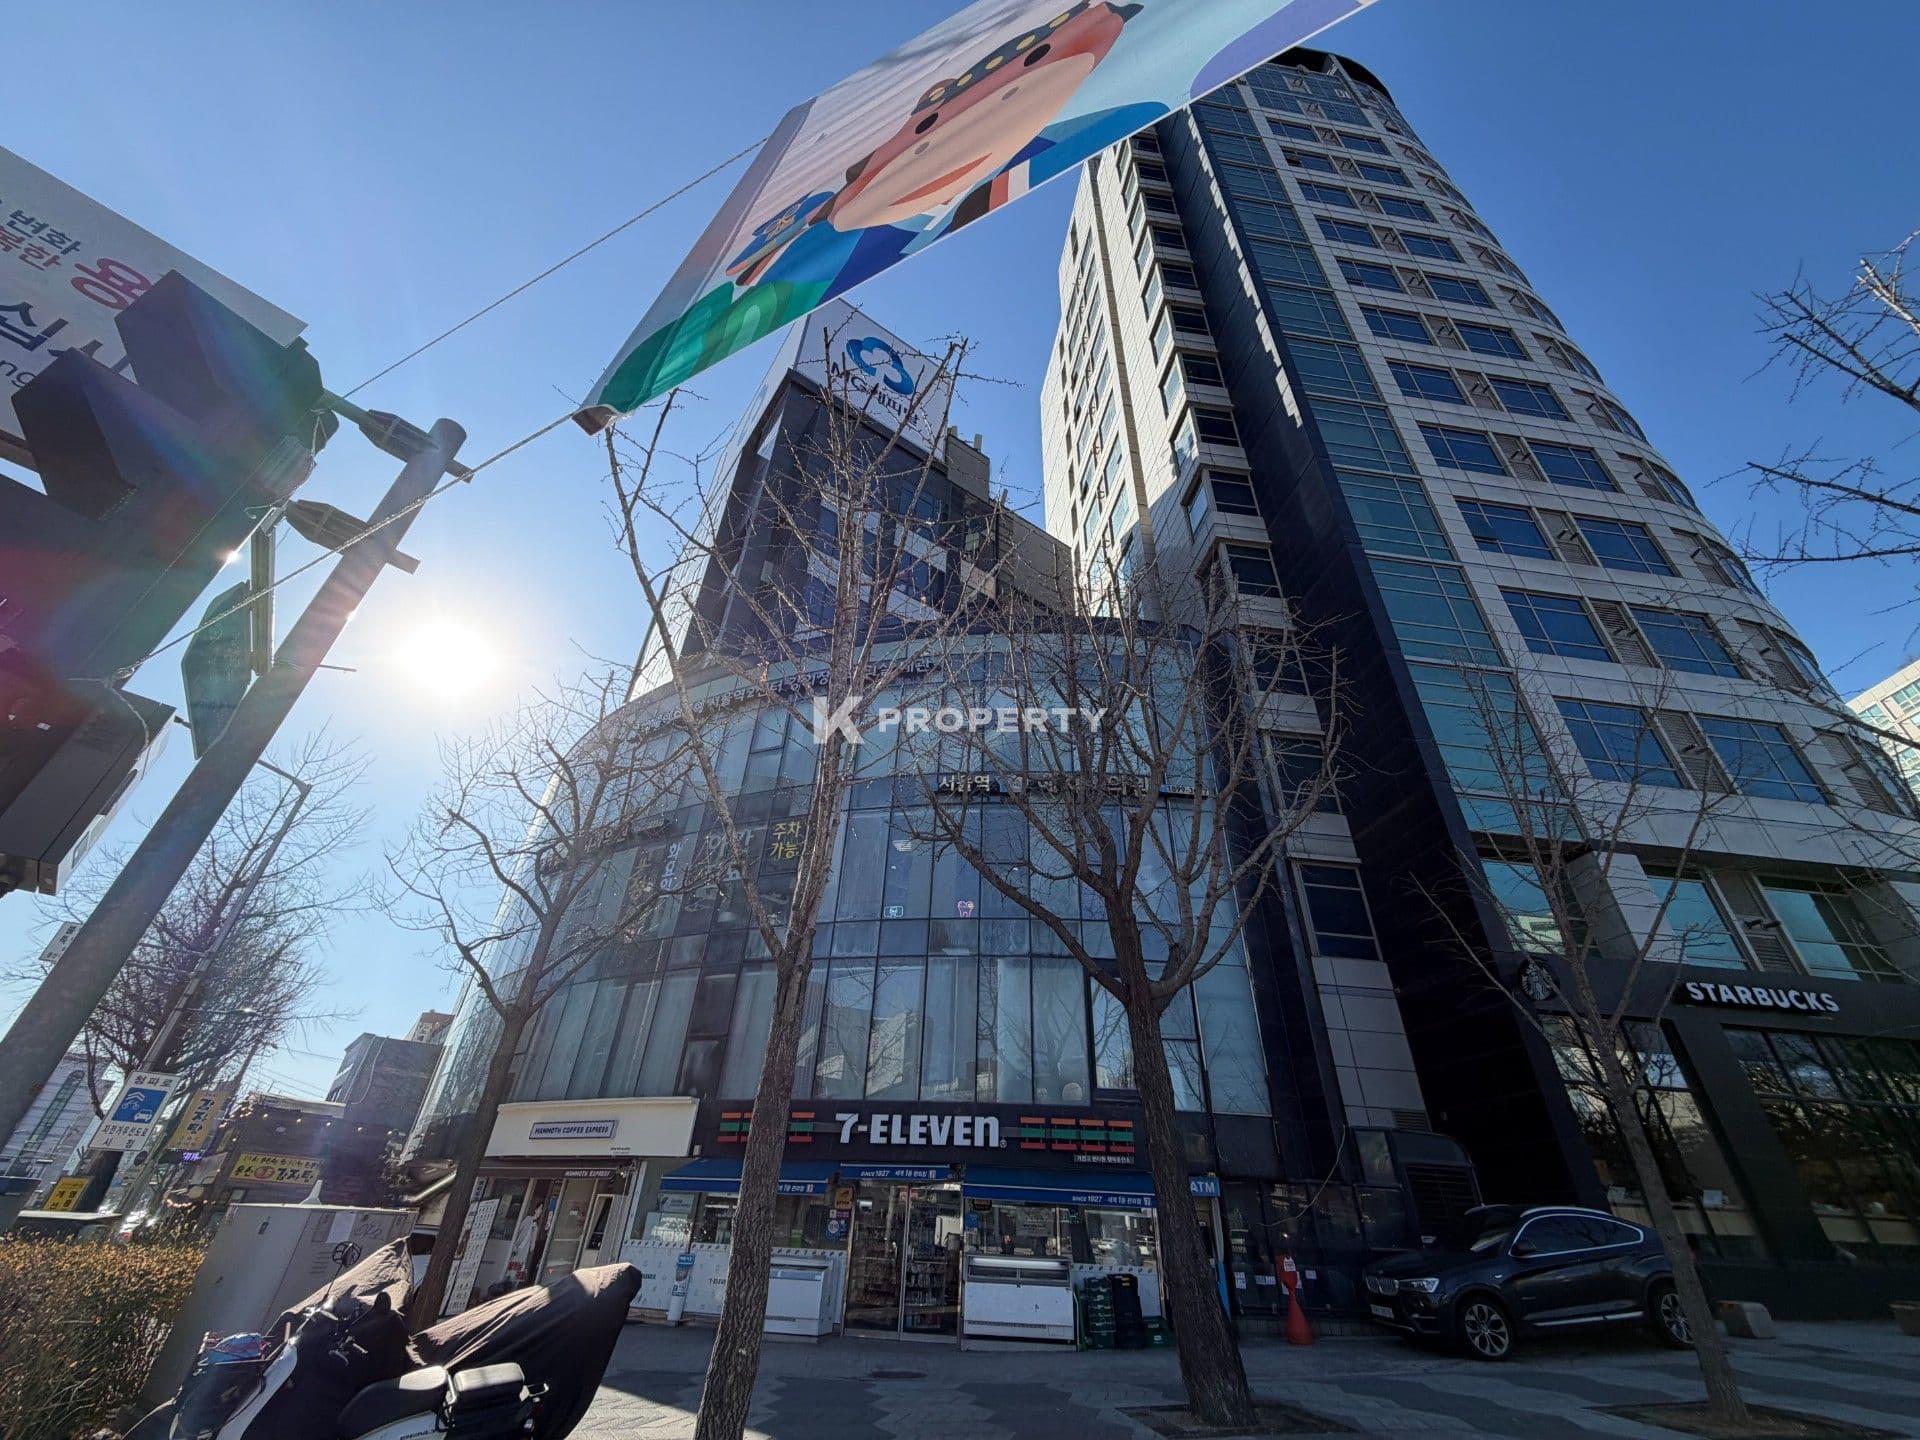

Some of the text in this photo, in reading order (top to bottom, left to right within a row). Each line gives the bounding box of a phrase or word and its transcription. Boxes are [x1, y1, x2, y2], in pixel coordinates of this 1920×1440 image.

[6, 209, 82, 256] 변화
[939, 774, 991, 793] 서울역
[773, 821, 801, 840] 주차
[769, 842, 798, 860] 가능
[1685, 981, 1840, 1013] STARBUCKS
[134, 1075, 173, 1088] 청파로
[534, 1126, 609, 1135] MAMMOTH COFFEE EXPRESS
[1189, 1181, 1215, 1194] ATM
